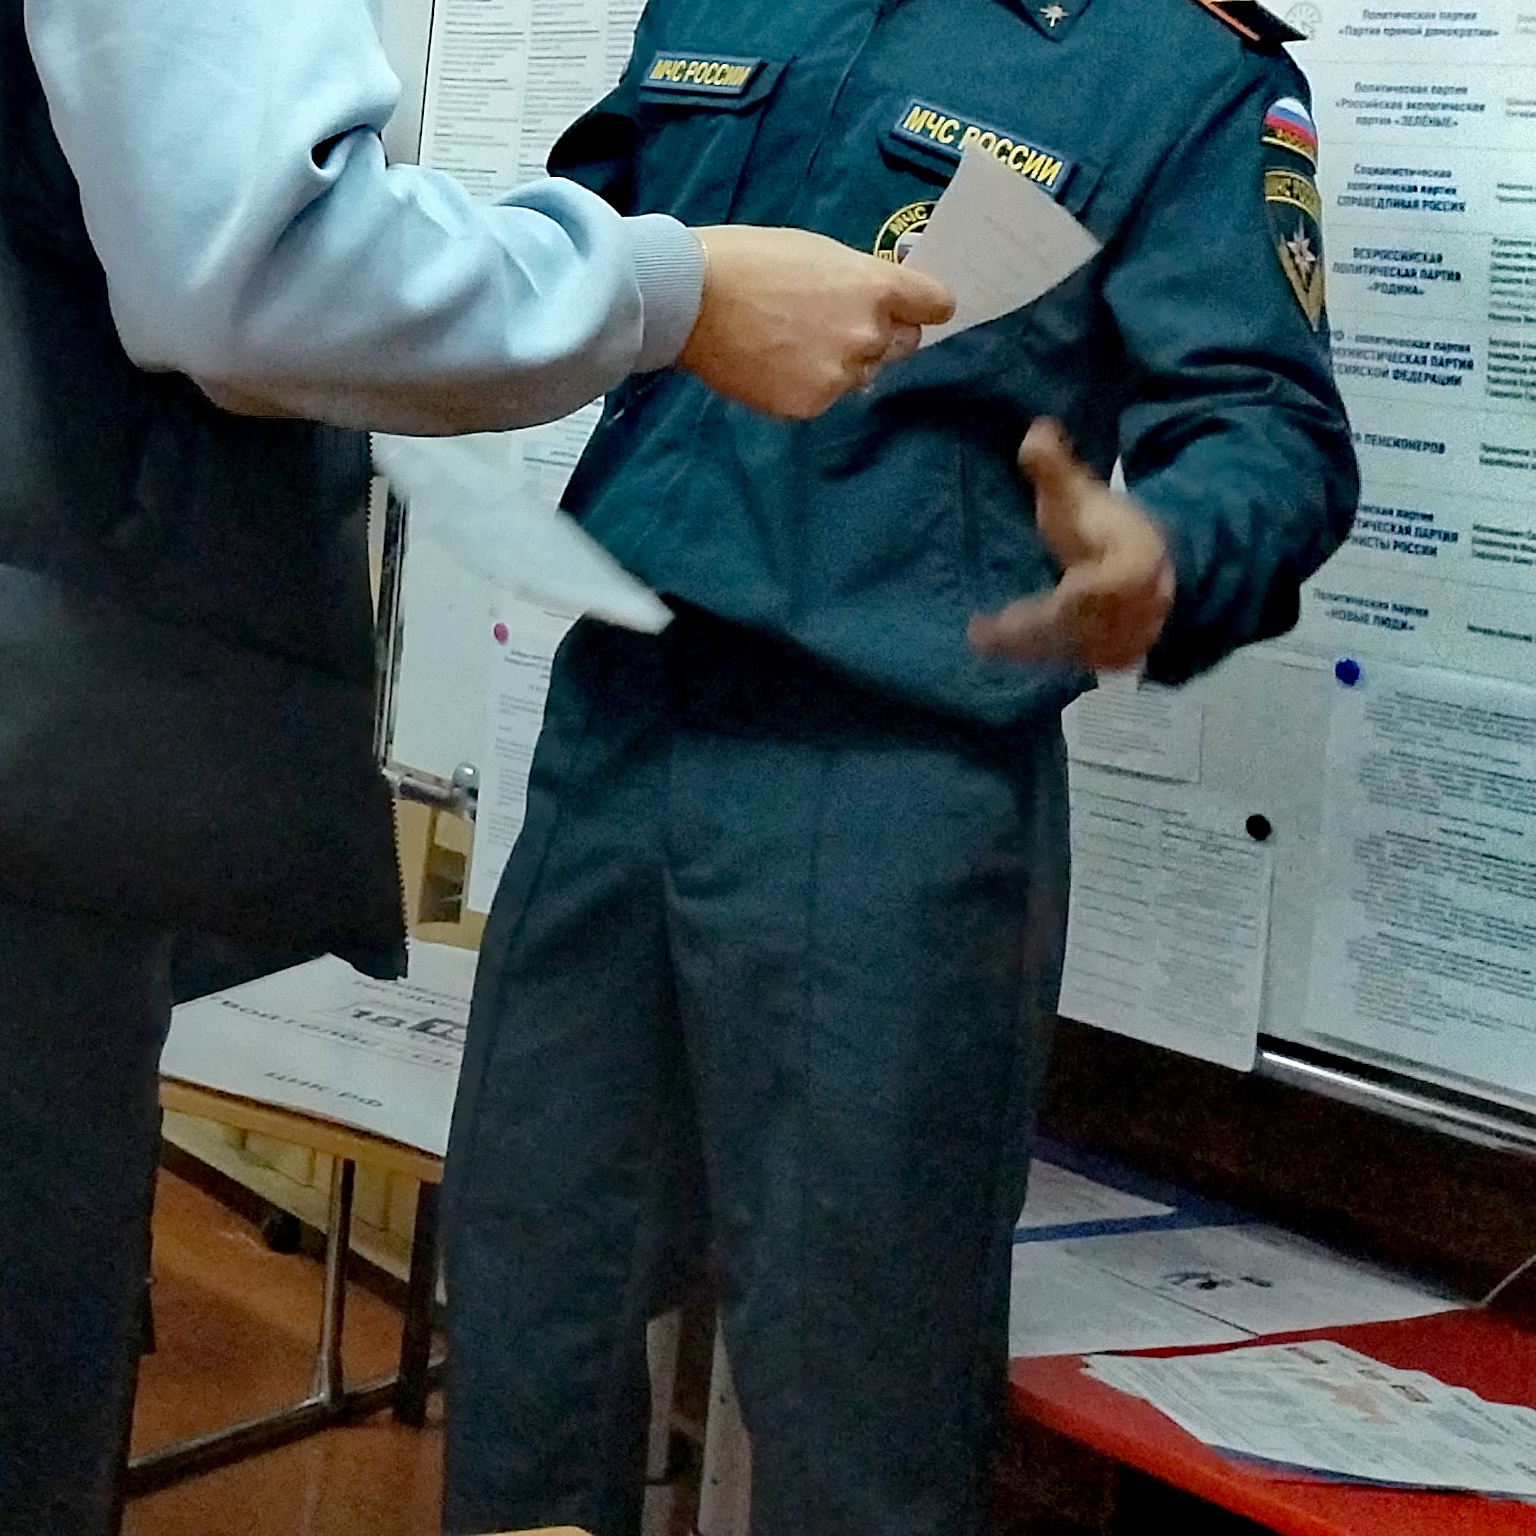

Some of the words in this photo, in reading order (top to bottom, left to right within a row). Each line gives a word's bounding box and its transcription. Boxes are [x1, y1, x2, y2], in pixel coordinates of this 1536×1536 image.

[903, 105, 960, 144] МЧС
[958, 125, 1063, 187] РОССИИ
[888, 205, 928, 236] МЧС
